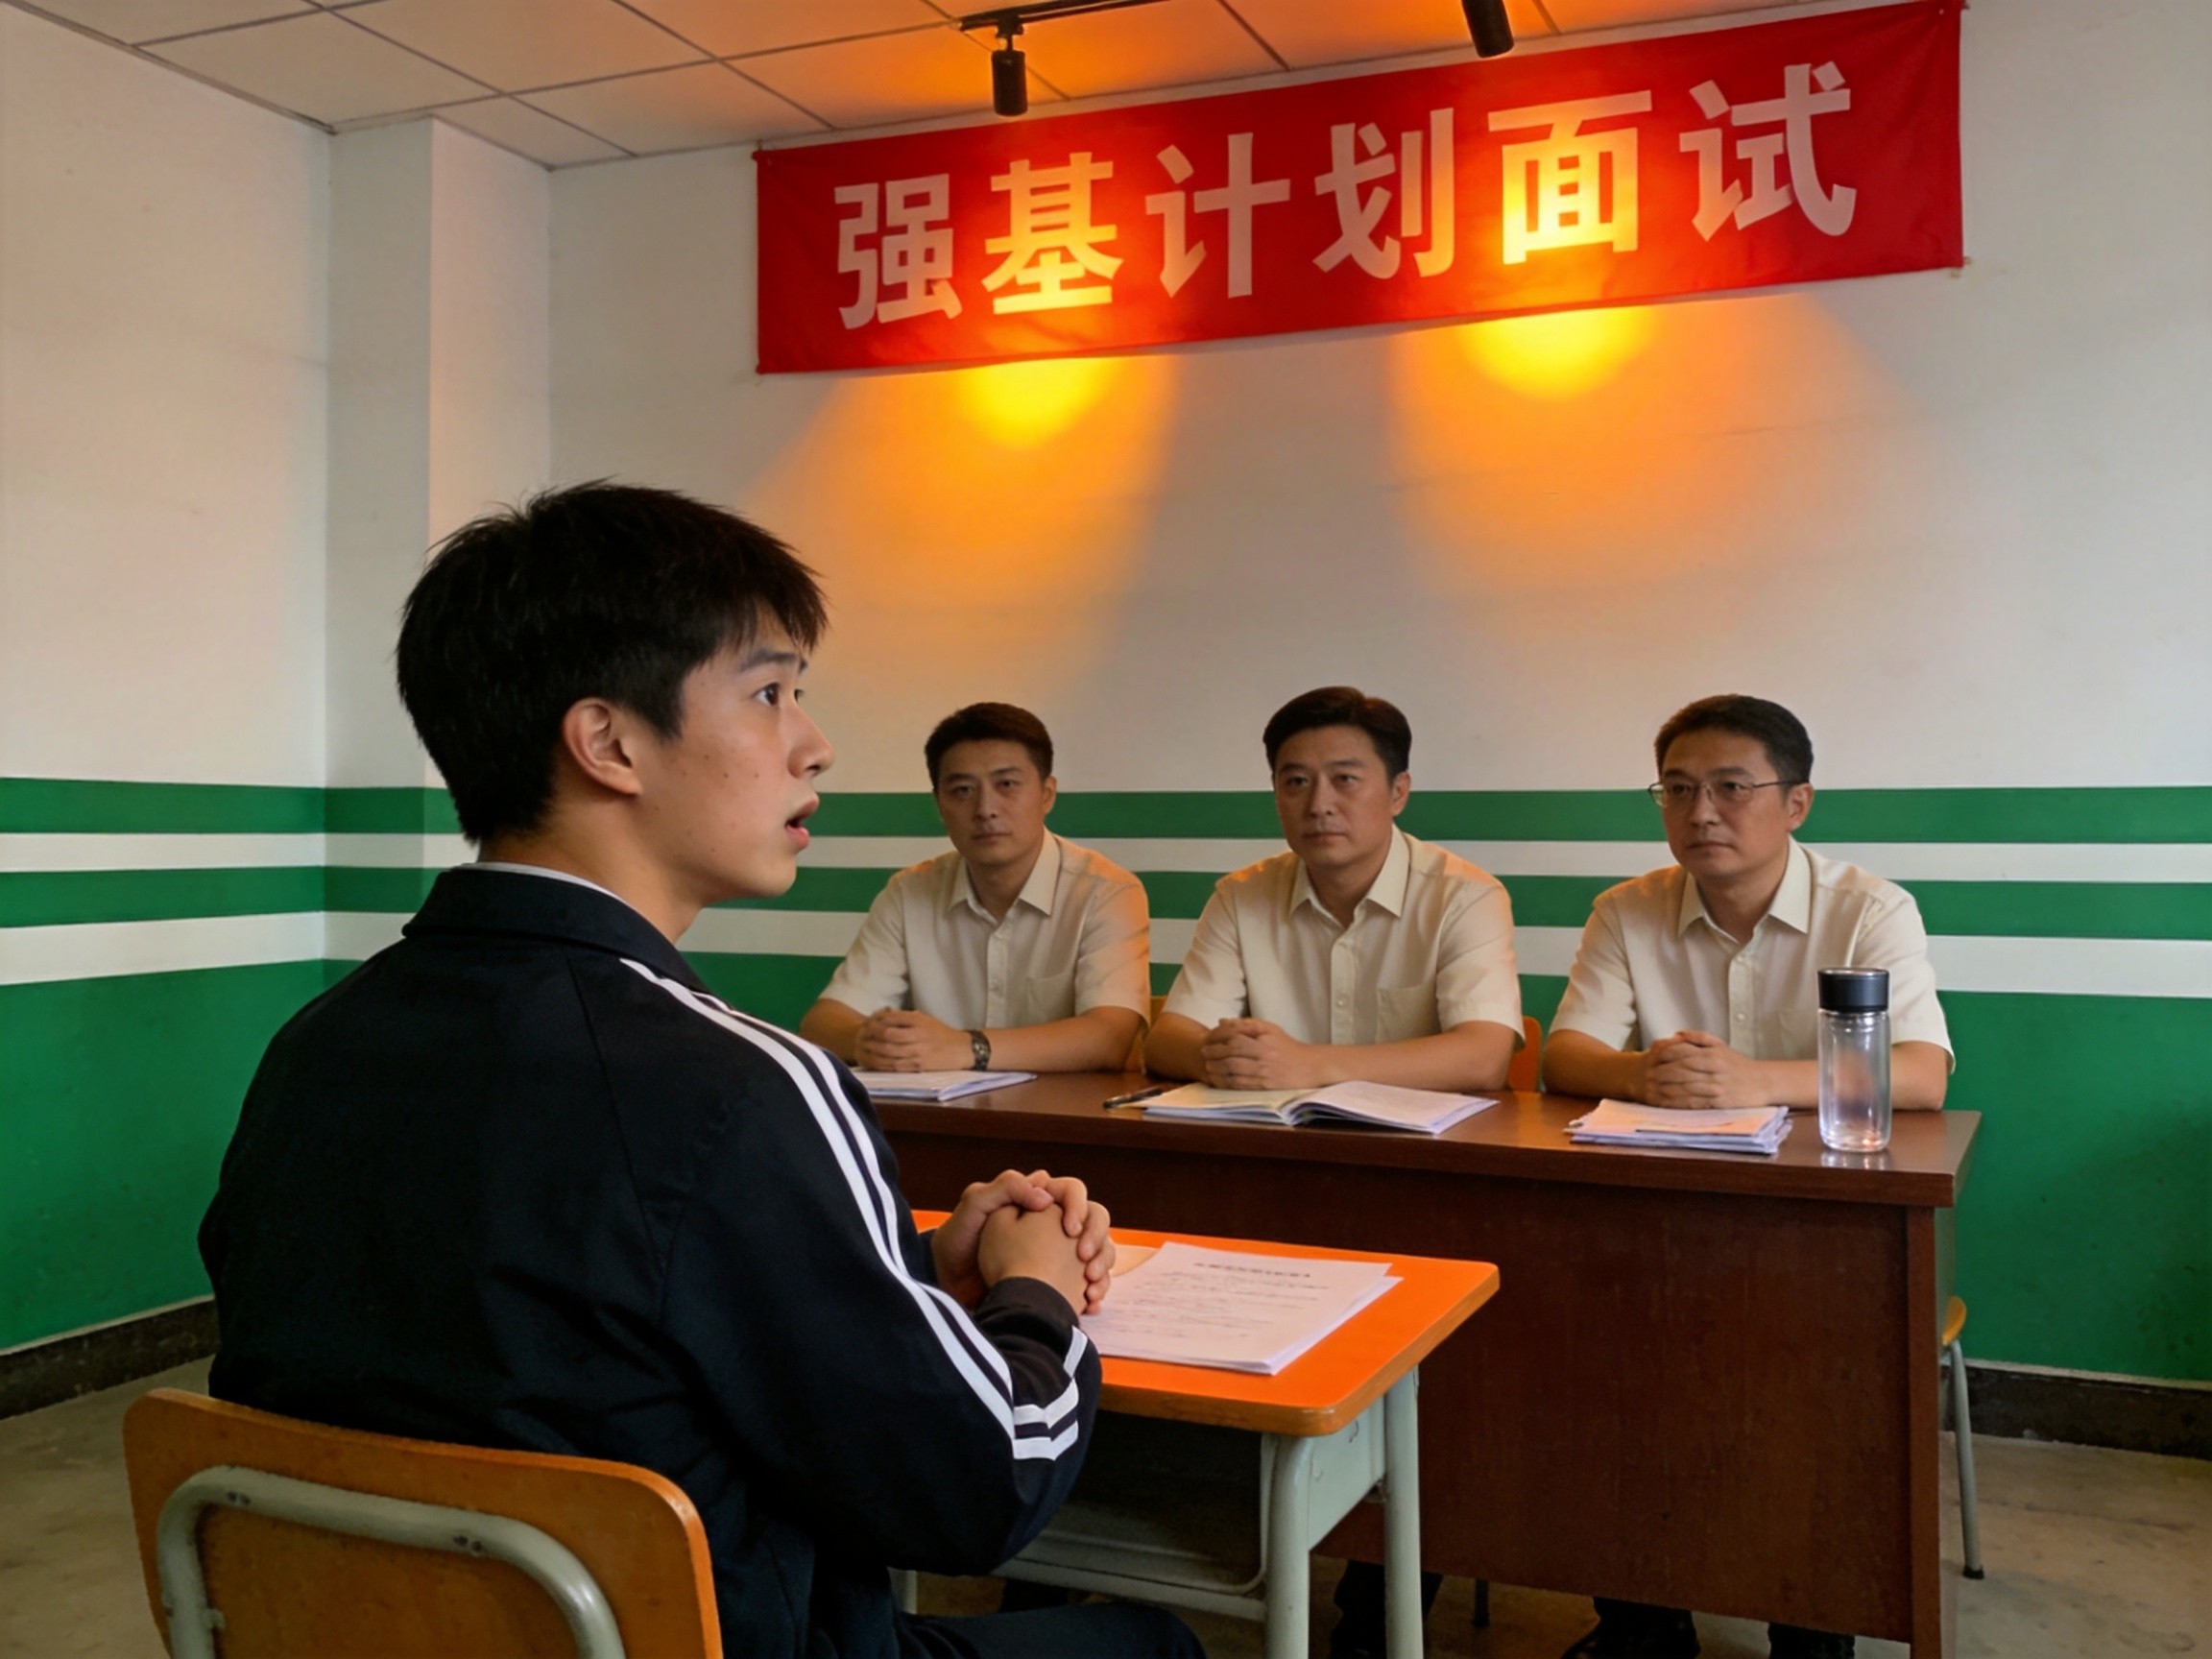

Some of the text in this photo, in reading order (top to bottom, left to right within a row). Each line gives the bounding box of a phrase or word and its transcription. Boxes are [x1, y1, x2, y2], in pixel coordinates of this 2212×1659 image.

[834, 61, 1858, 329] 强基计划面试
